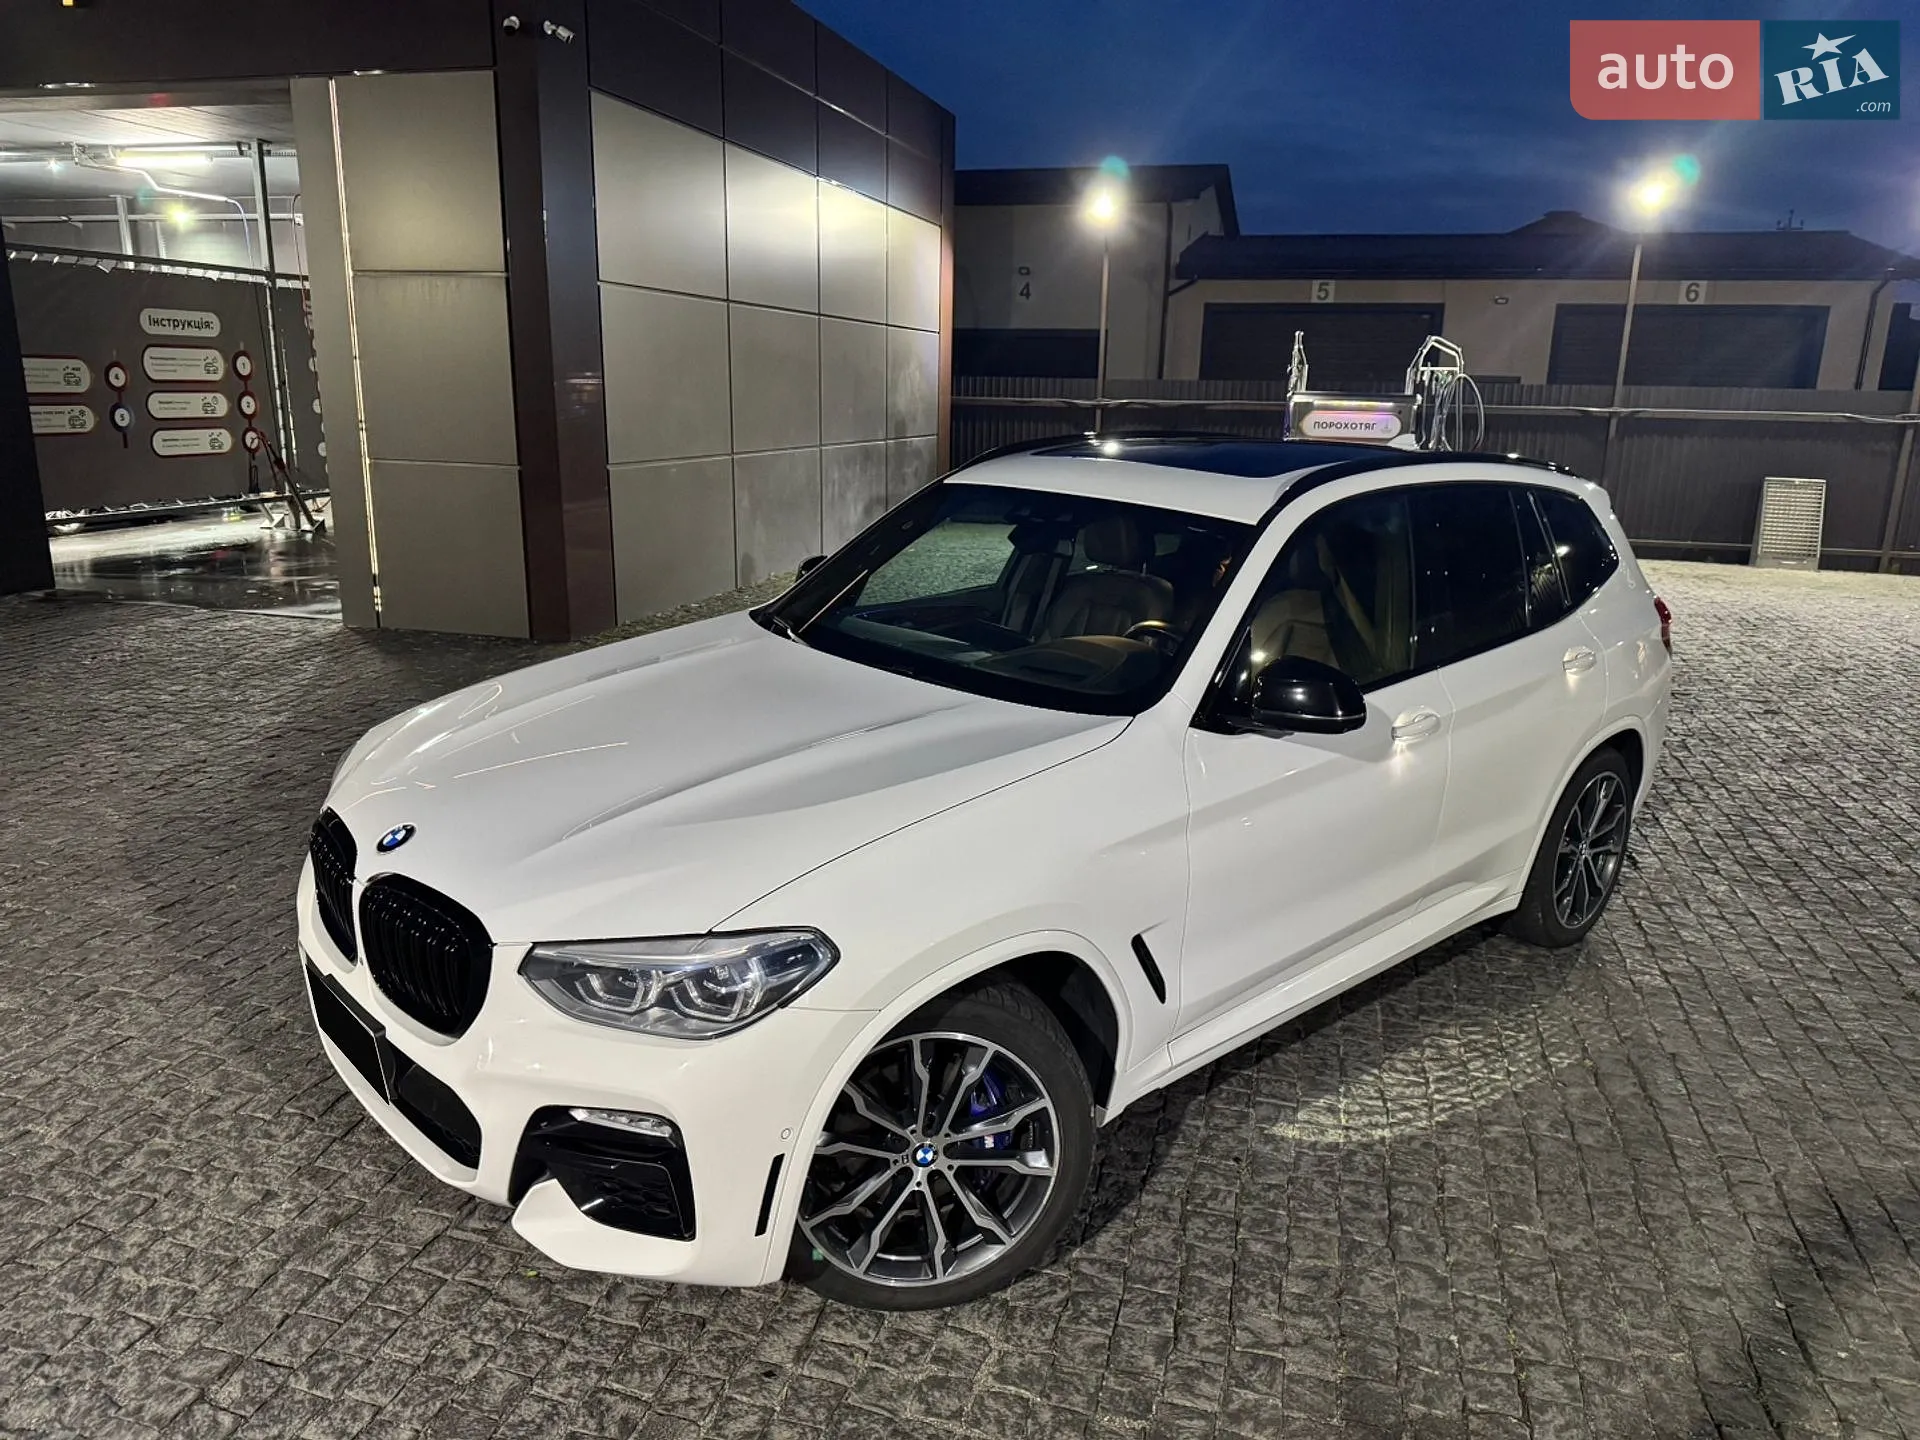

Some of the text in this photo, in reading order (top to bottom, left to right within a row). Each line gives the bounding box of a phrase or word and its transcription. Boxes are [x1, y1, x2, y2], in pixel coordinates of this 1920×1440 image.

[1019, 281, 1031, 300] 4
[1317, 282, 1329, 300] 5
[1685, 282, 1700, 302] 6
[148, 314, 214, 331] Інструкція:
[1313, 420, 1377, 431] ПОРОХОТЯГ
